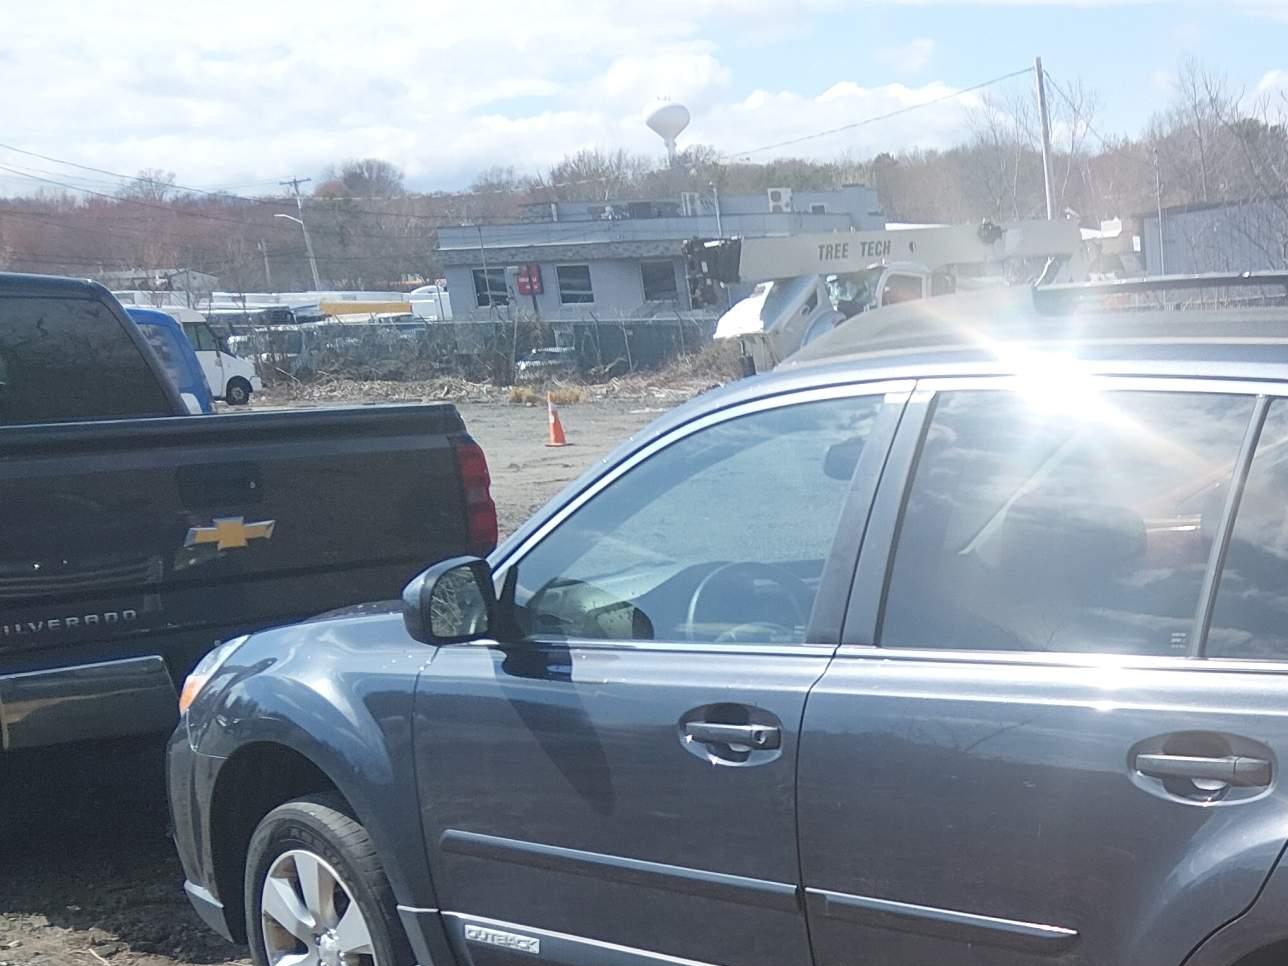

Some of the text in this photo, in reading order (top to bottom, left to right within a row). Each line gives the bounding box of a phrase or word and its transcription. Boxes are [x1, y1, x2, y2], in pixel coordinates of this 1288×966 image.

[818, 240, 891, 260] TREE TECH
[467, 928, 539, 954] OUTBACK
